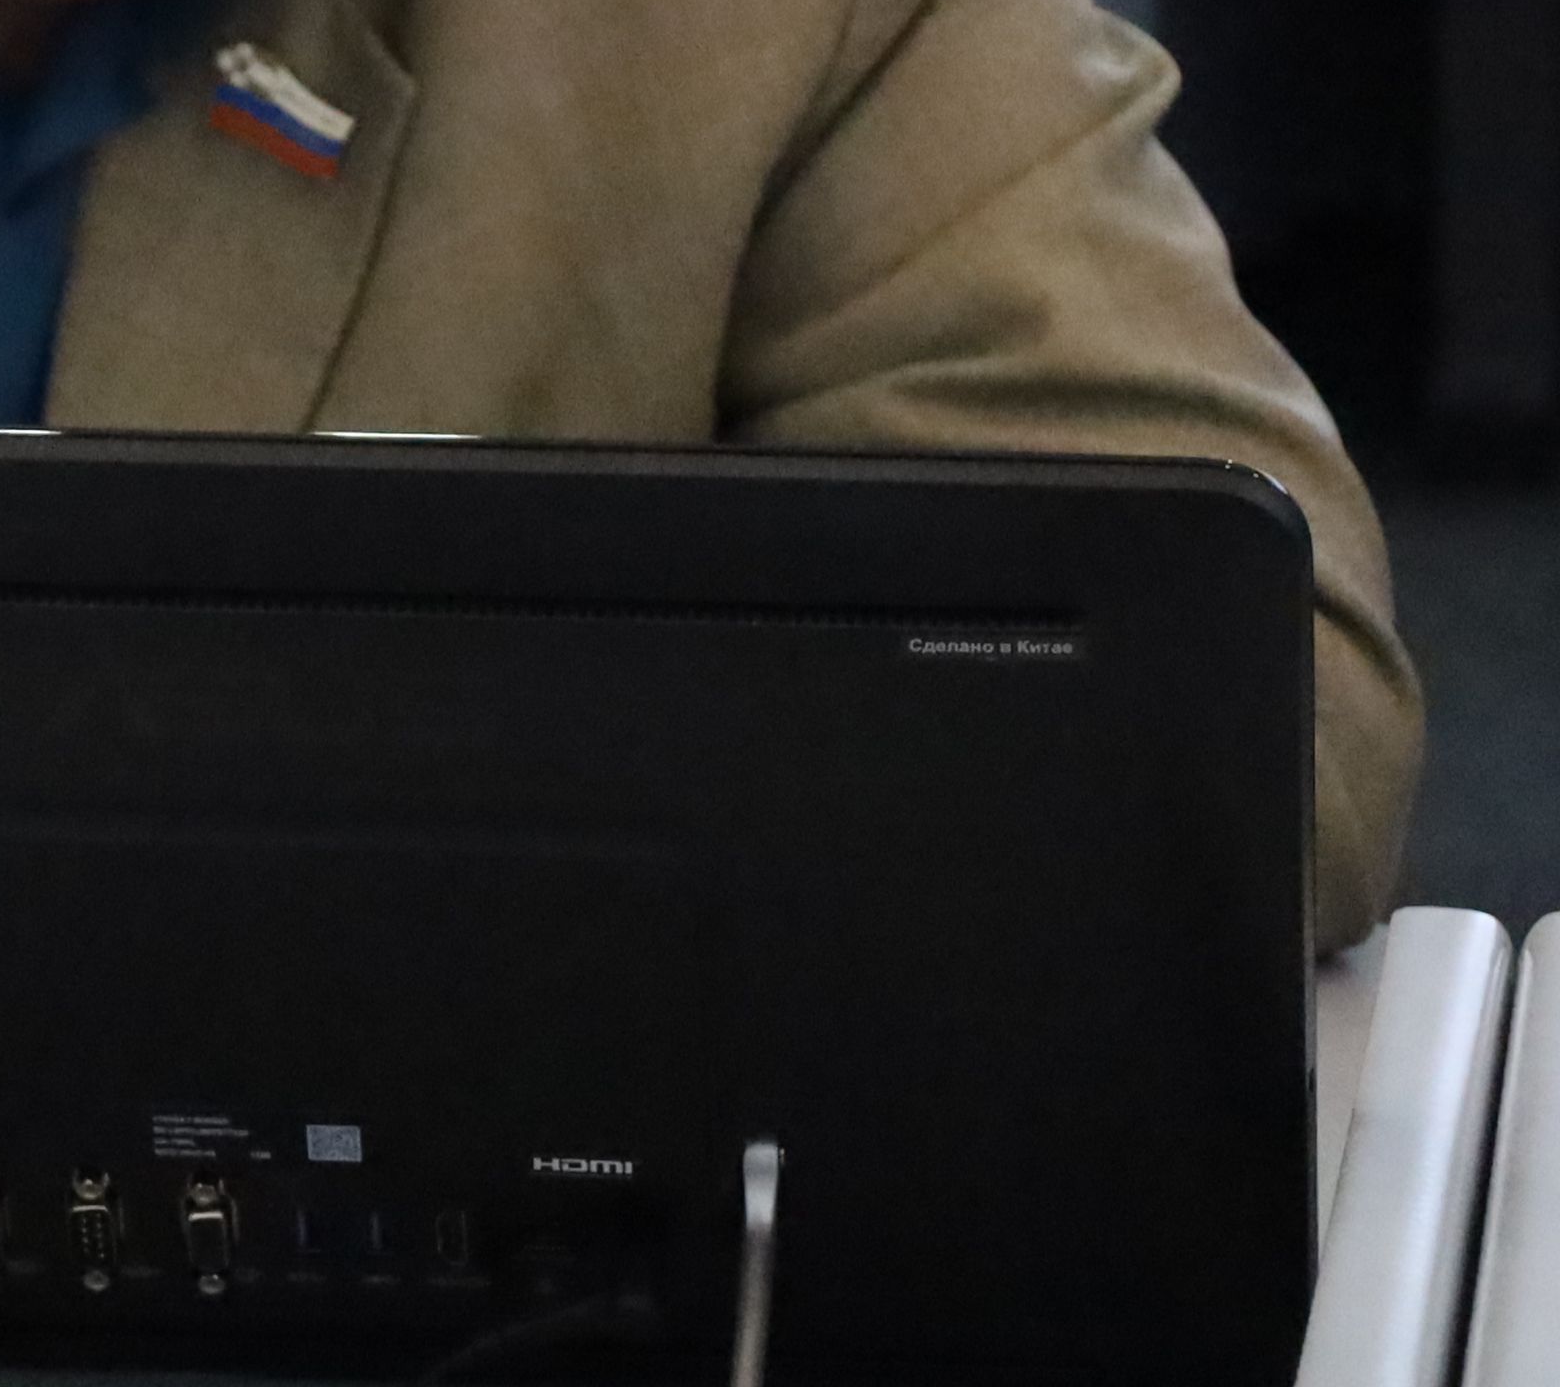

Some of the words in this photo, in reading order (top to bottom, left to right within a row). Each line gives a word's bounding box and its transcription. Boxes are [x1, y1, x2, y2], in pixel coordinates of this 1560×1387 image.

[909, 638, 994, 655] Сделано
[1000, 642, 1012, 654] в
[1017, 639, 1073, 655] Китае
